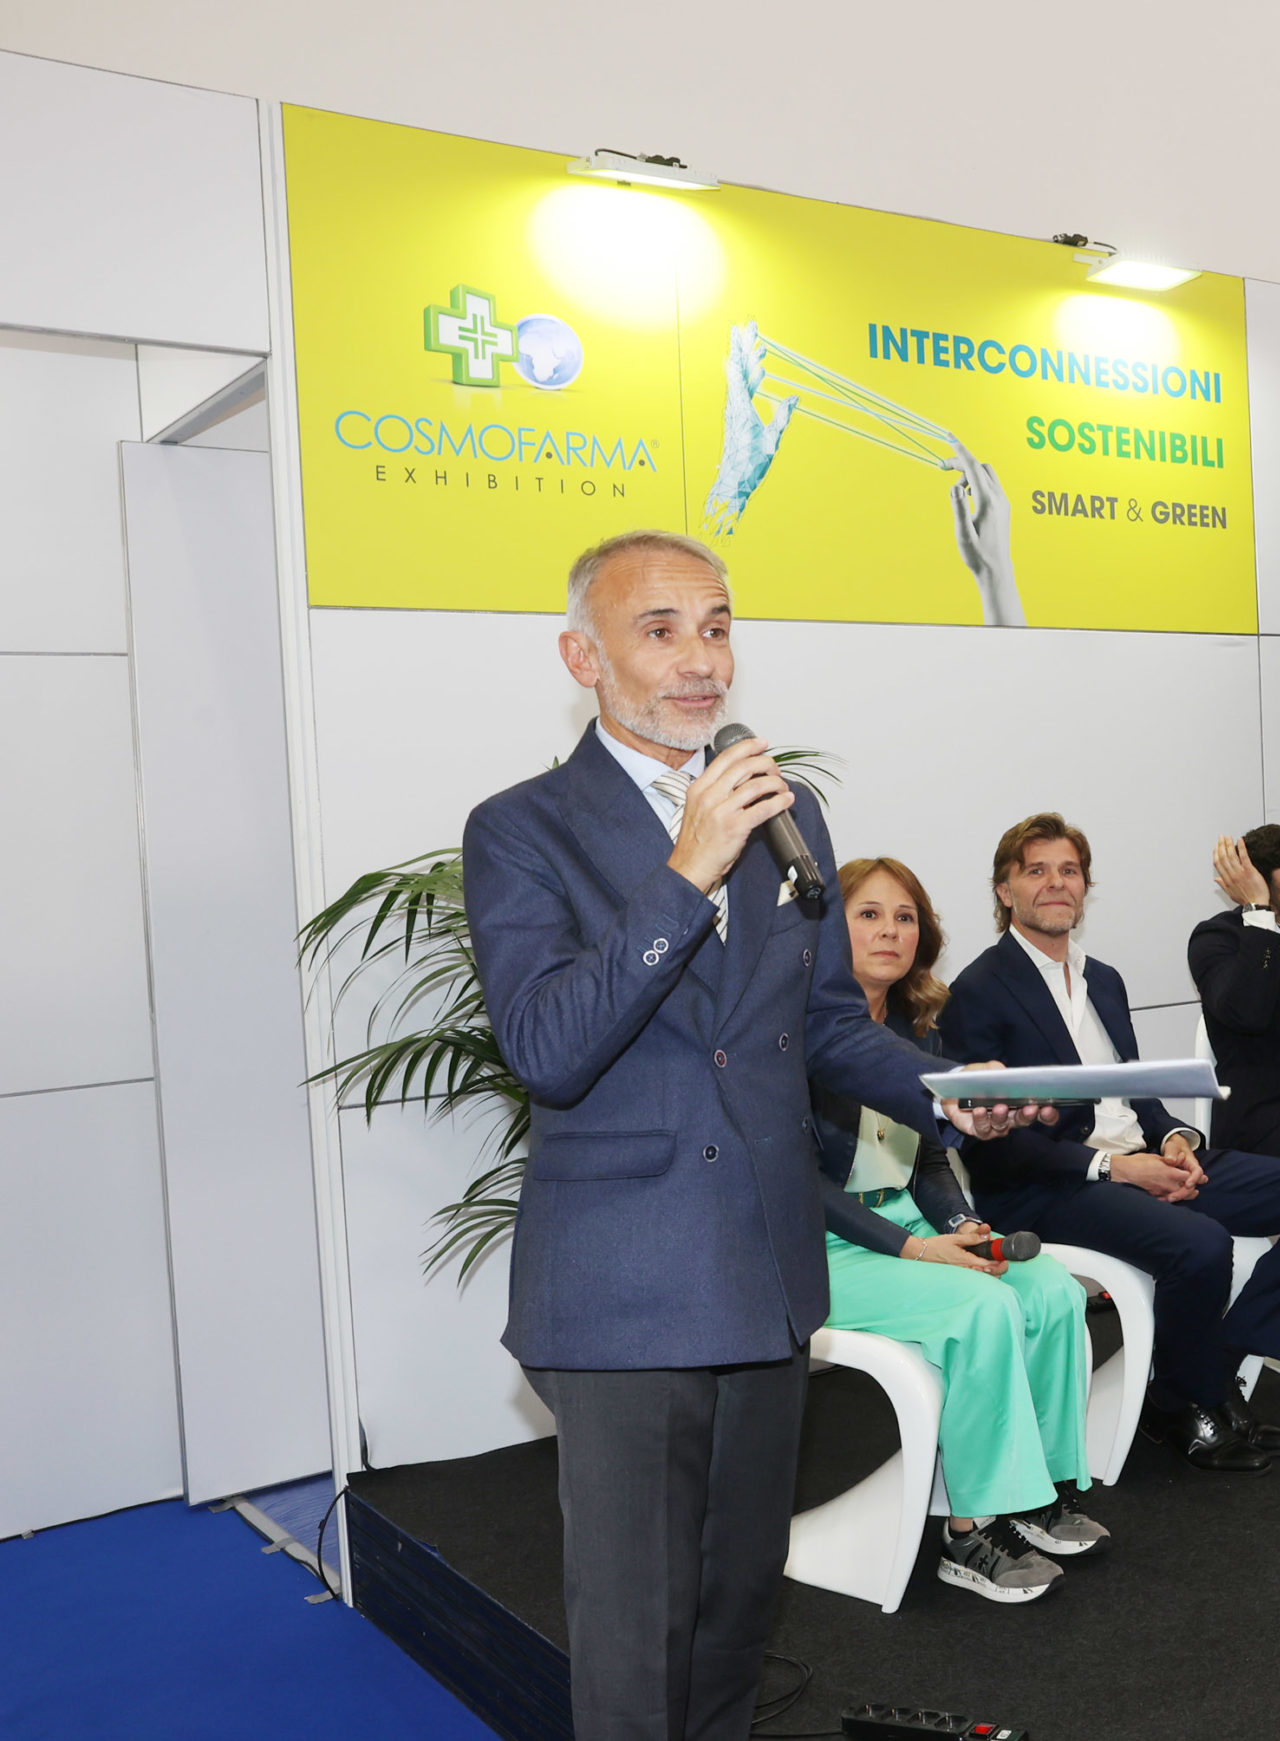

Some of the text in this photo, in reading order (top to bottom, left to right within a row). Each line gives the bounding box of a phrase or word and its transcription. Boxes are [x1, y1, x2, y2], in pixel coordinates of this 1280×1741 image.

[868, 322, 1221, 403] INTERCONNESSIONI
[1026, 415, 1224, 468] SOSTENIBILI
[376, 464, 625, 498] EXHIBITION
[1031, 489, 1227, 529] SMART & GREEN
